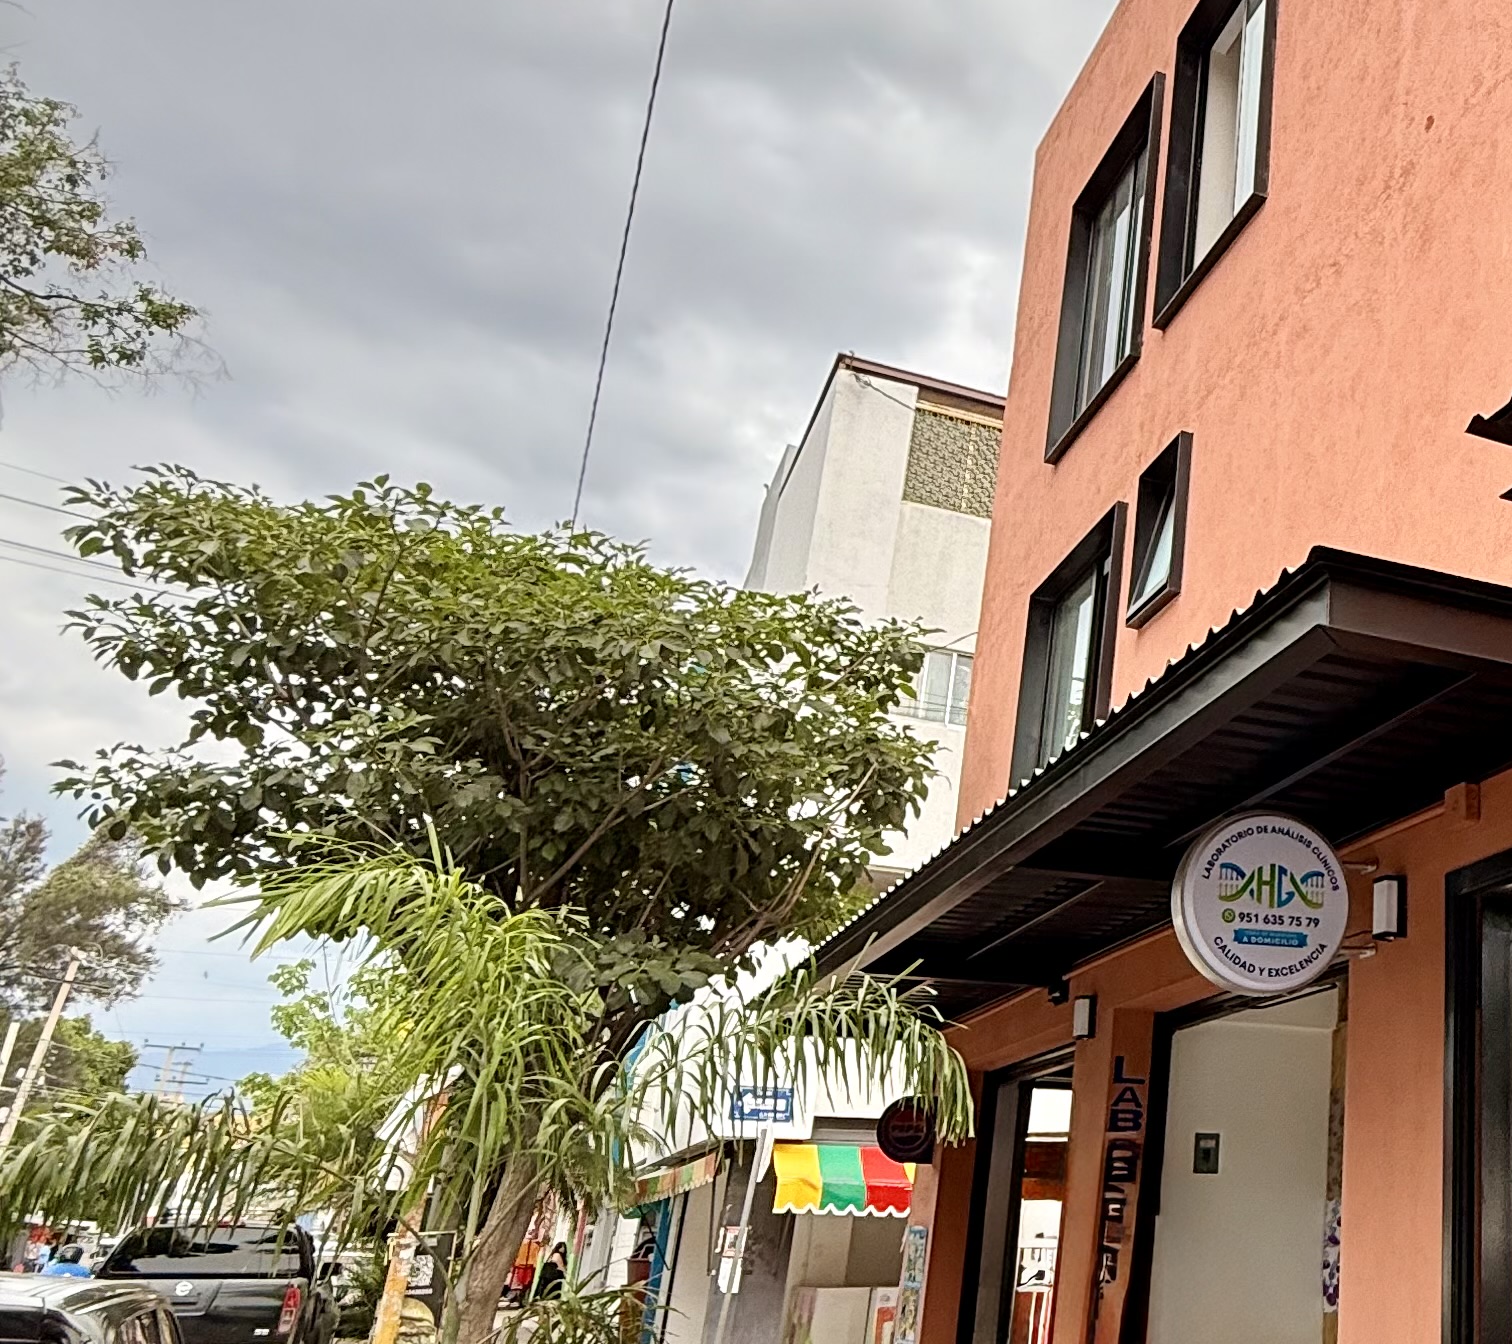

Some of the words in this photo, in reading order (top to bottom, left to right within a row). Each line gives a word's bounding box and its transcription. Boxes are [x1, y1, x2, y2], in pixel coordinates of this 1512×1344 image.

[1202, 827, 1255, 880] LABORATORIO
[1256, 825, 1269, 835] DE
[1270, 826, 1313, 849] ANÁLISIS
[1311, 846, 1340, 892] CLÍNICOS
[1238, 912, 1259, 924] 951
[1263, 914, 1285, 926] 635
[1288, 915, 1303, 927] 75
[1305, 917, 1320, 929] 79
[1250, 936, 1299, 946] DOMICILIO
[1213, 936, 1256, 973] CALIDAD
[1258, 966, 1267, 977] Y
[1267, 942, 1328, 977] EXCELENCIA
